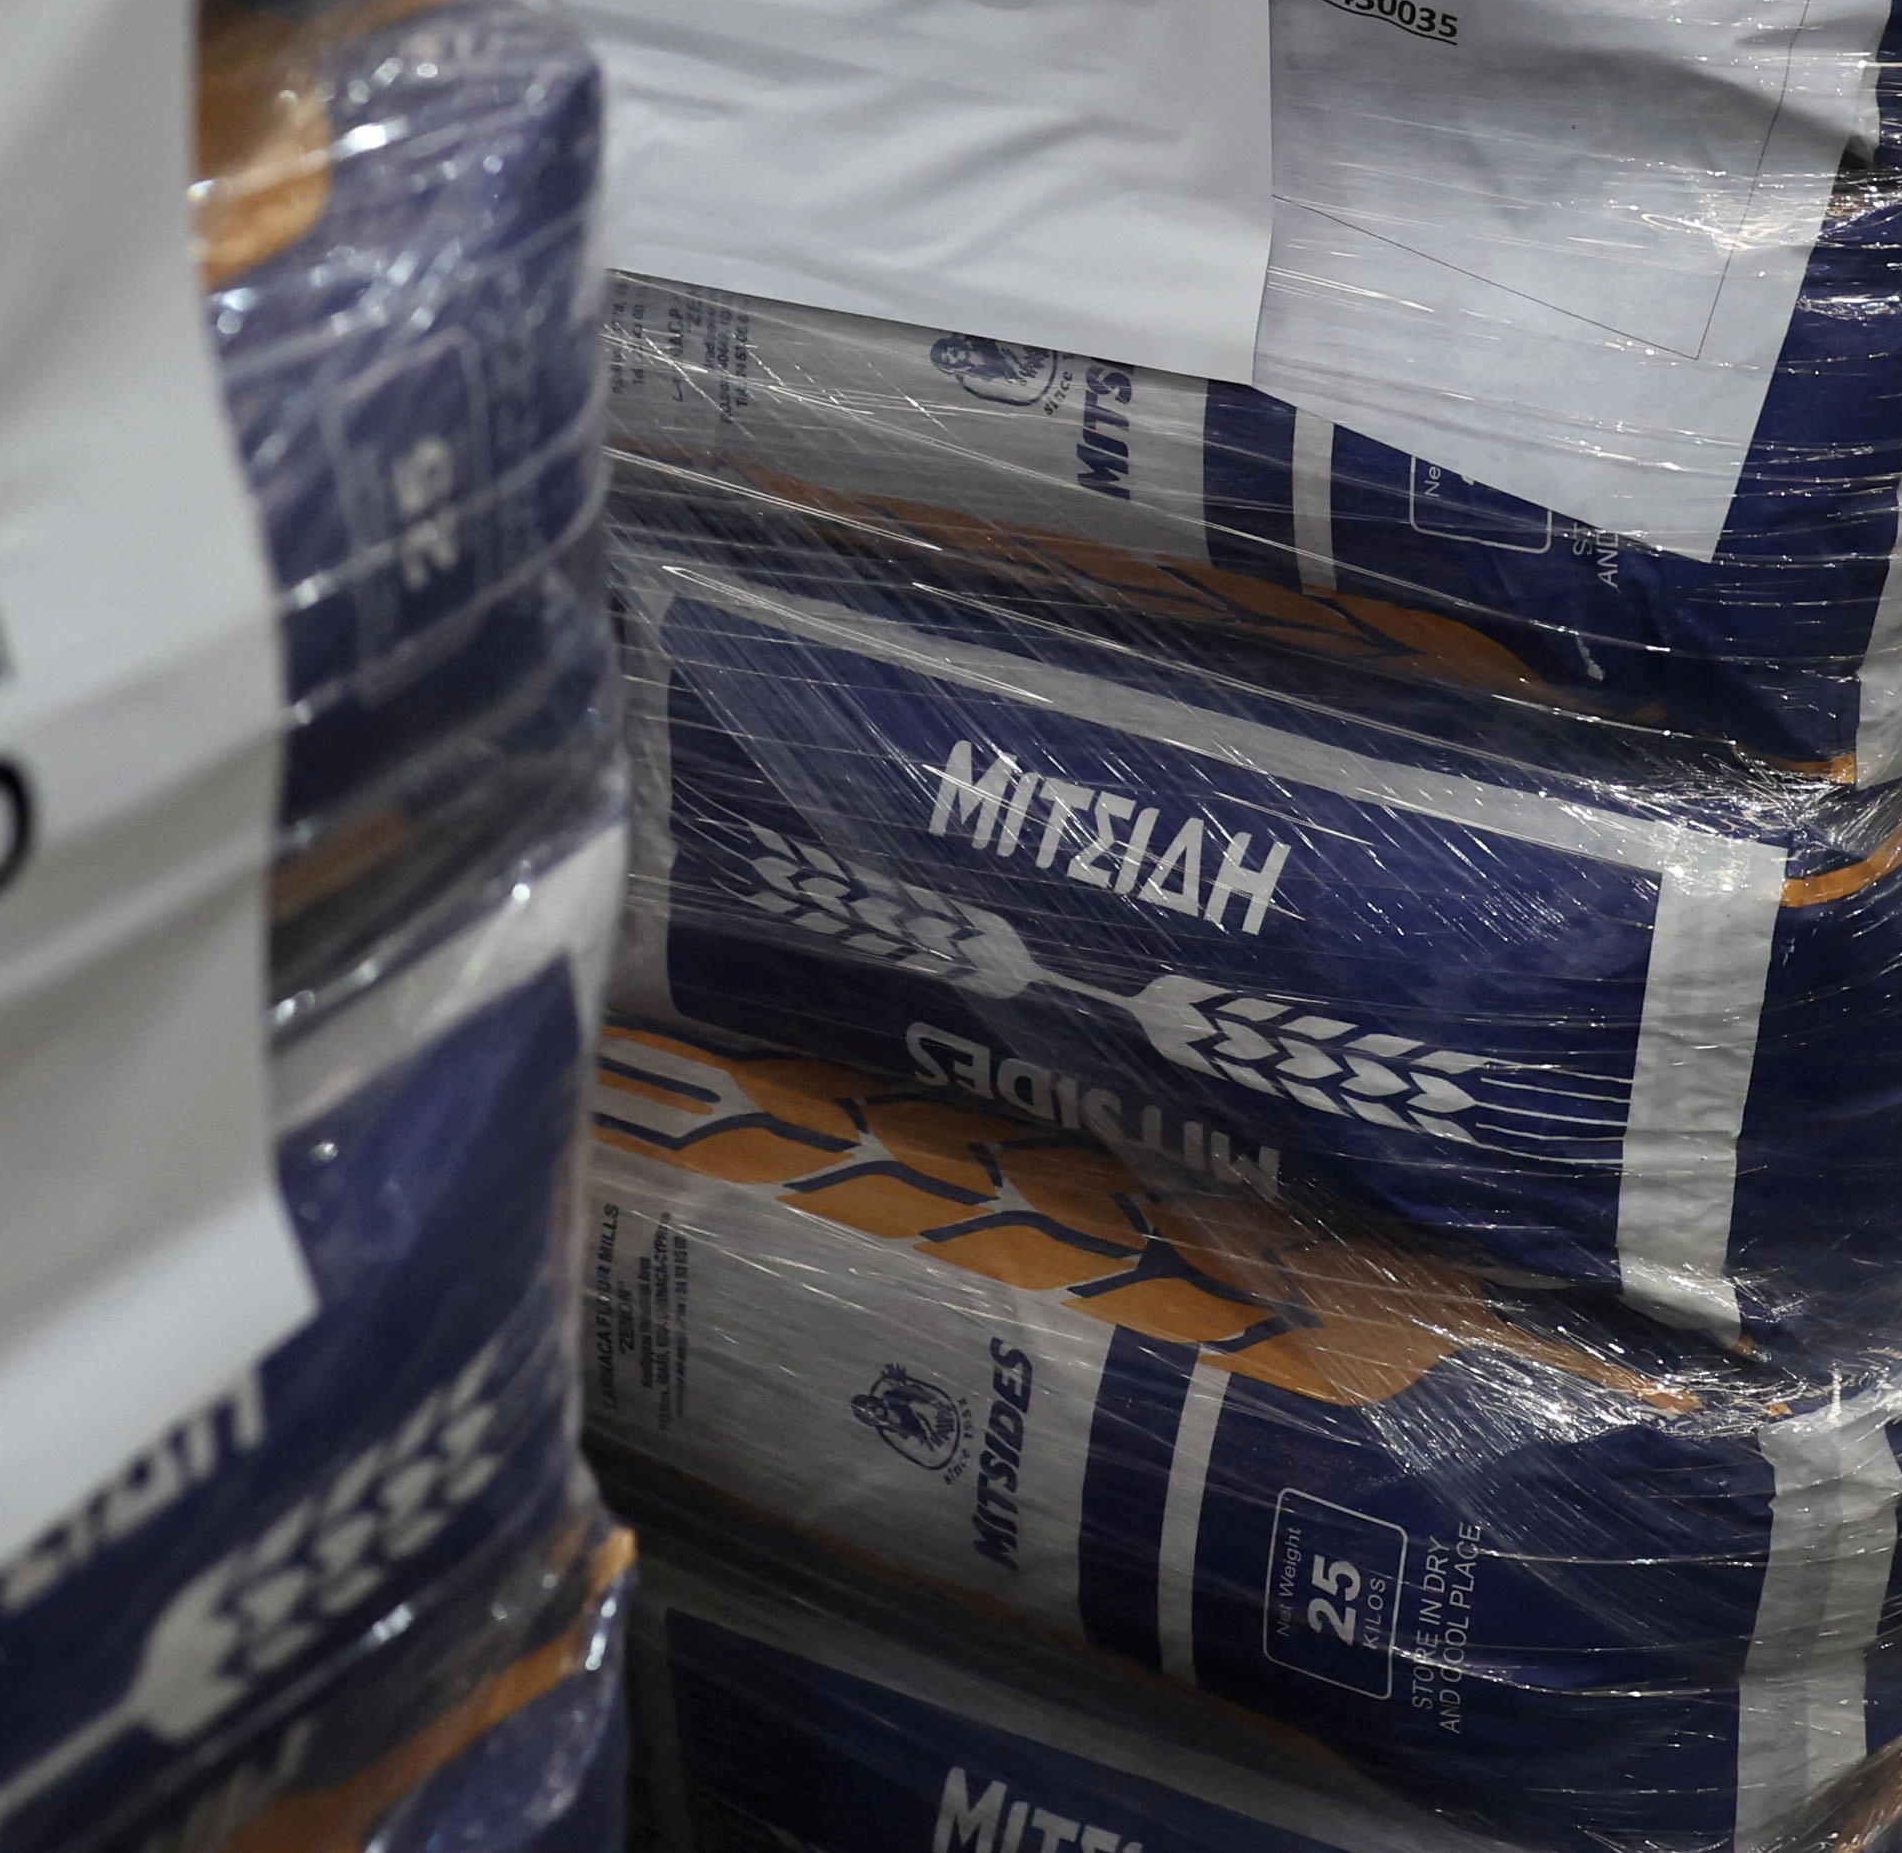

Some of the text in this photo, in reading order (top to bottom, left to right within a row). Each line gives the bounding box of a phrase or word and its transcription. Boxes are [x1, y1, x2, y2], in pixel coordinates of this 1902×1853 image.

[927, 739, 1293, 936] ΜΙΤΣΙΔΗ
[597, 1202, 620, 1262] MILLS
[971, 1335, 1034, 1573] MITSIDES
[1278, 1526, 1304, 1599] Weight
[1306, 1552, 1362, 1647] 25
[1361, 1576, 1387, 1651] KILOS
[1412, 1534, 1451, 1711] STORE IN DRY
[1439, 1522, 1483, 1734] AND COOL PLACE
